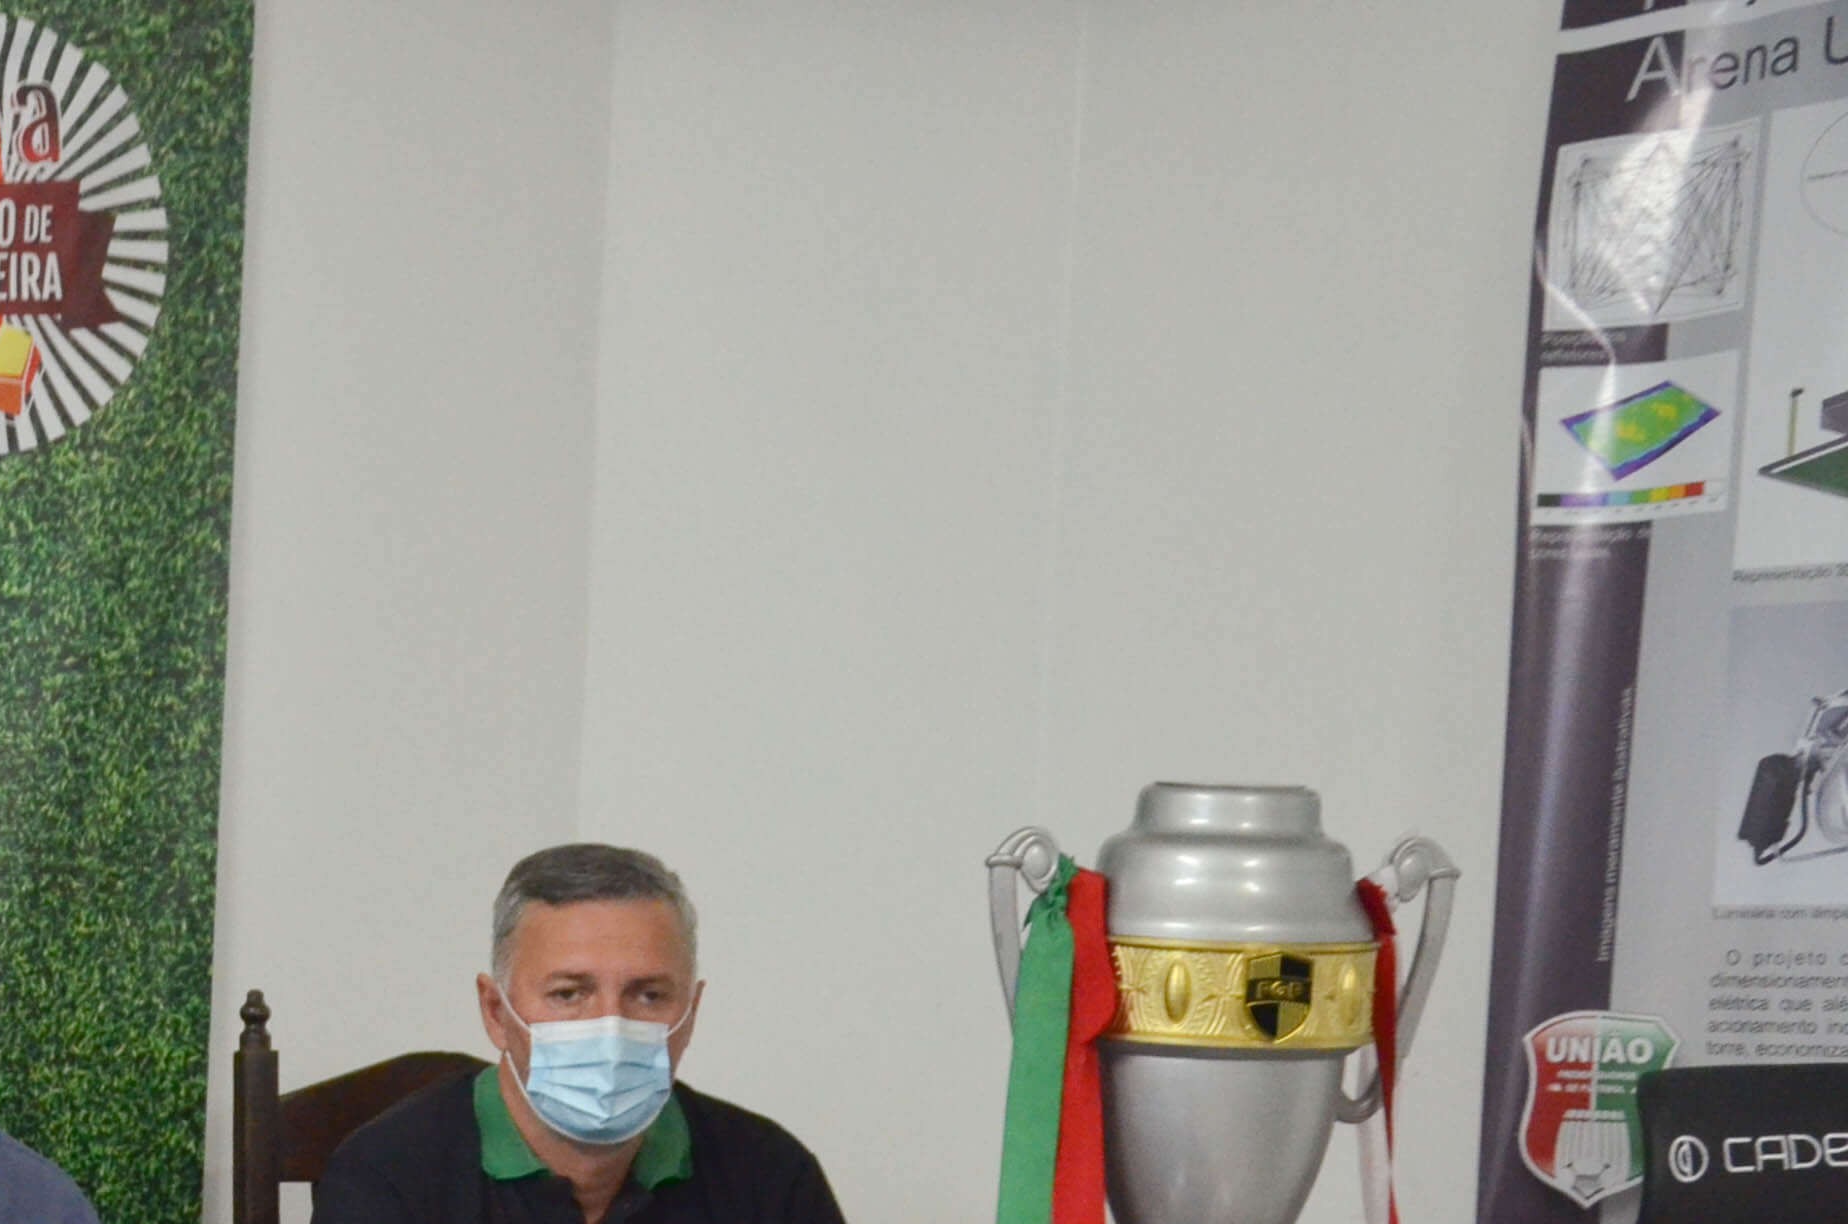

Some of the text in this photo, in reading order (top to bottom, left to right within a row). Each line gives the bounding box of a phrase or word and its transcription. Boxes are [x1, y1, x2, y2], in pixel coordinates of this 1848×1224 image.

[1624, 35, 1799, 102] Arena
[23, 204, 53, 244] DE
[1726, 949, 1742, 967] O
[1752, 950, 1828, 970] projeto
